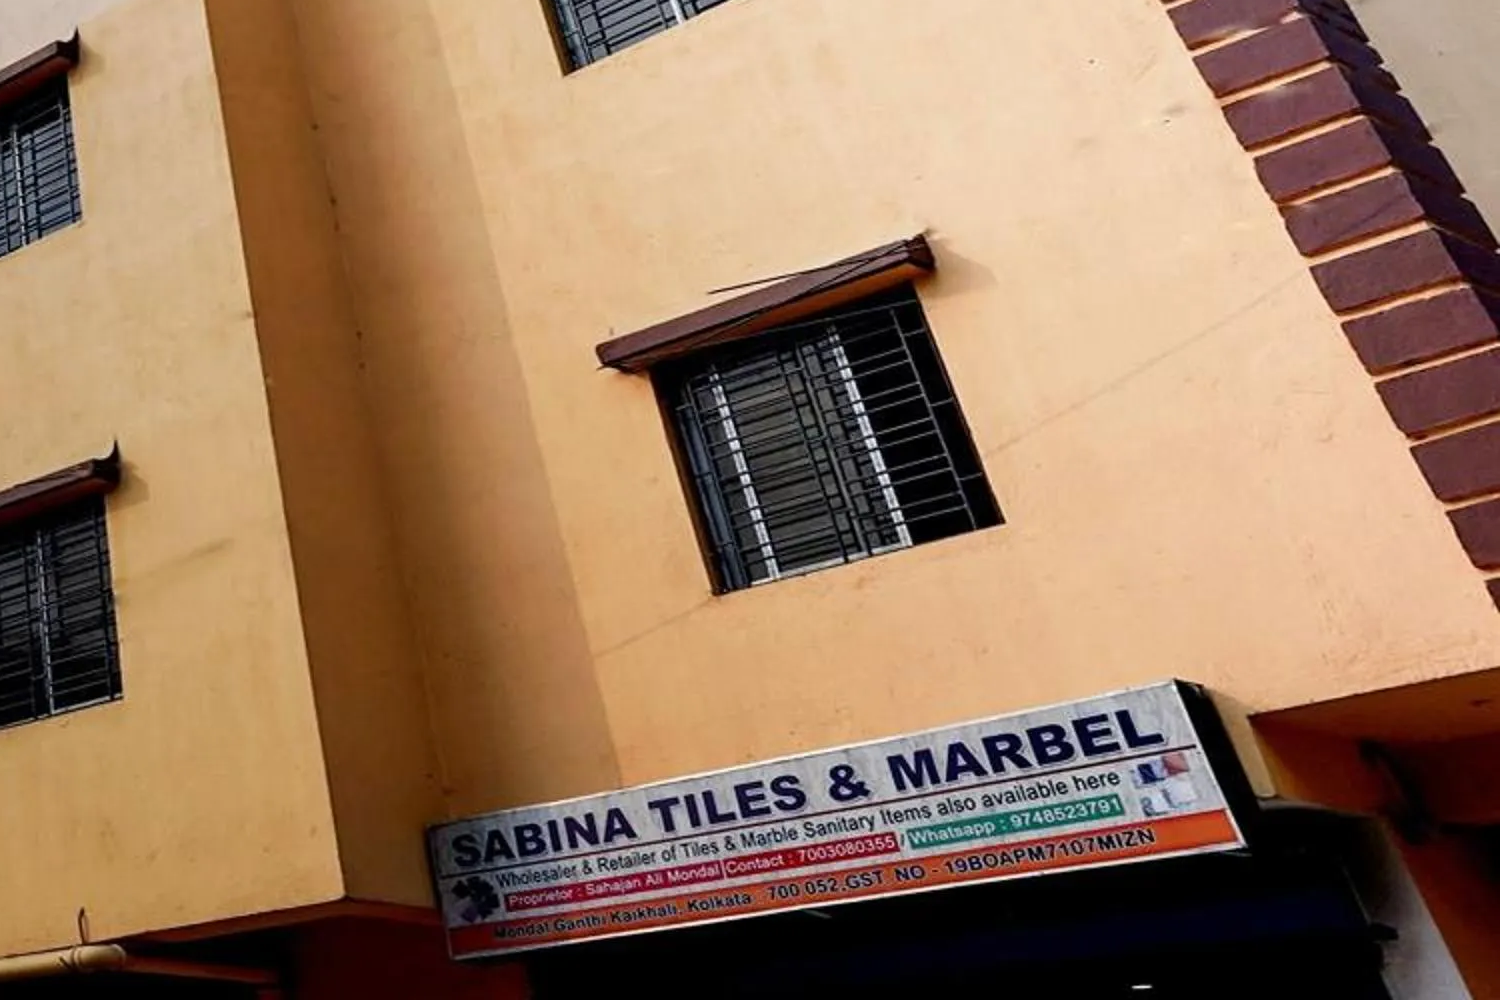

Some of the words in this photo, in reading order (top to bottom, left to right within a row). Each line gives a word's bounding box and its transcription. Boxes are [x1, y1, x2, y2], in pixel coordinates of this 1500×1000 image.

[451, 808, 637, 867] SABINA
[648, 774, 807, 833] TILES
[828, 764, 871, 802] &
[886, 709, 1165, 792] MARBEL
[495, 863, 577, 888] Wholesaler
[583, 860, 594, 876] &
[597, 849, 656, 873] Retailer
[662, 844, 677, 862] of
[680, 838, 720, 859] Tiles
[724, 834, 736, 851] &
[740, 826, 799, 850] Marble
[804, 813, 876, 838] Sanitary
[880, 804, 931, 826] Items
[937, 799, 976, 816] also
[982, 779, 1069, 808] available
[1073, 770, 1121, 792] here
[509, 887, 573, 906] Proprietor
[586, 876, 641, 896] Sahajan
[645, 873, 663, 888] Ali
[667, 864, 721, 883] Mondal
[726, 855, 785, 875] Contact
[798, 835, 896, 862] 7003080355
[909, 821, 997, 845] Whatsapp
[1010, 796, 1122, 829] 9748523791
[687, 893, 752, 912] Kolkata
[768, 883, 800, 900] 700
[895, 865, 925, 881] NO
